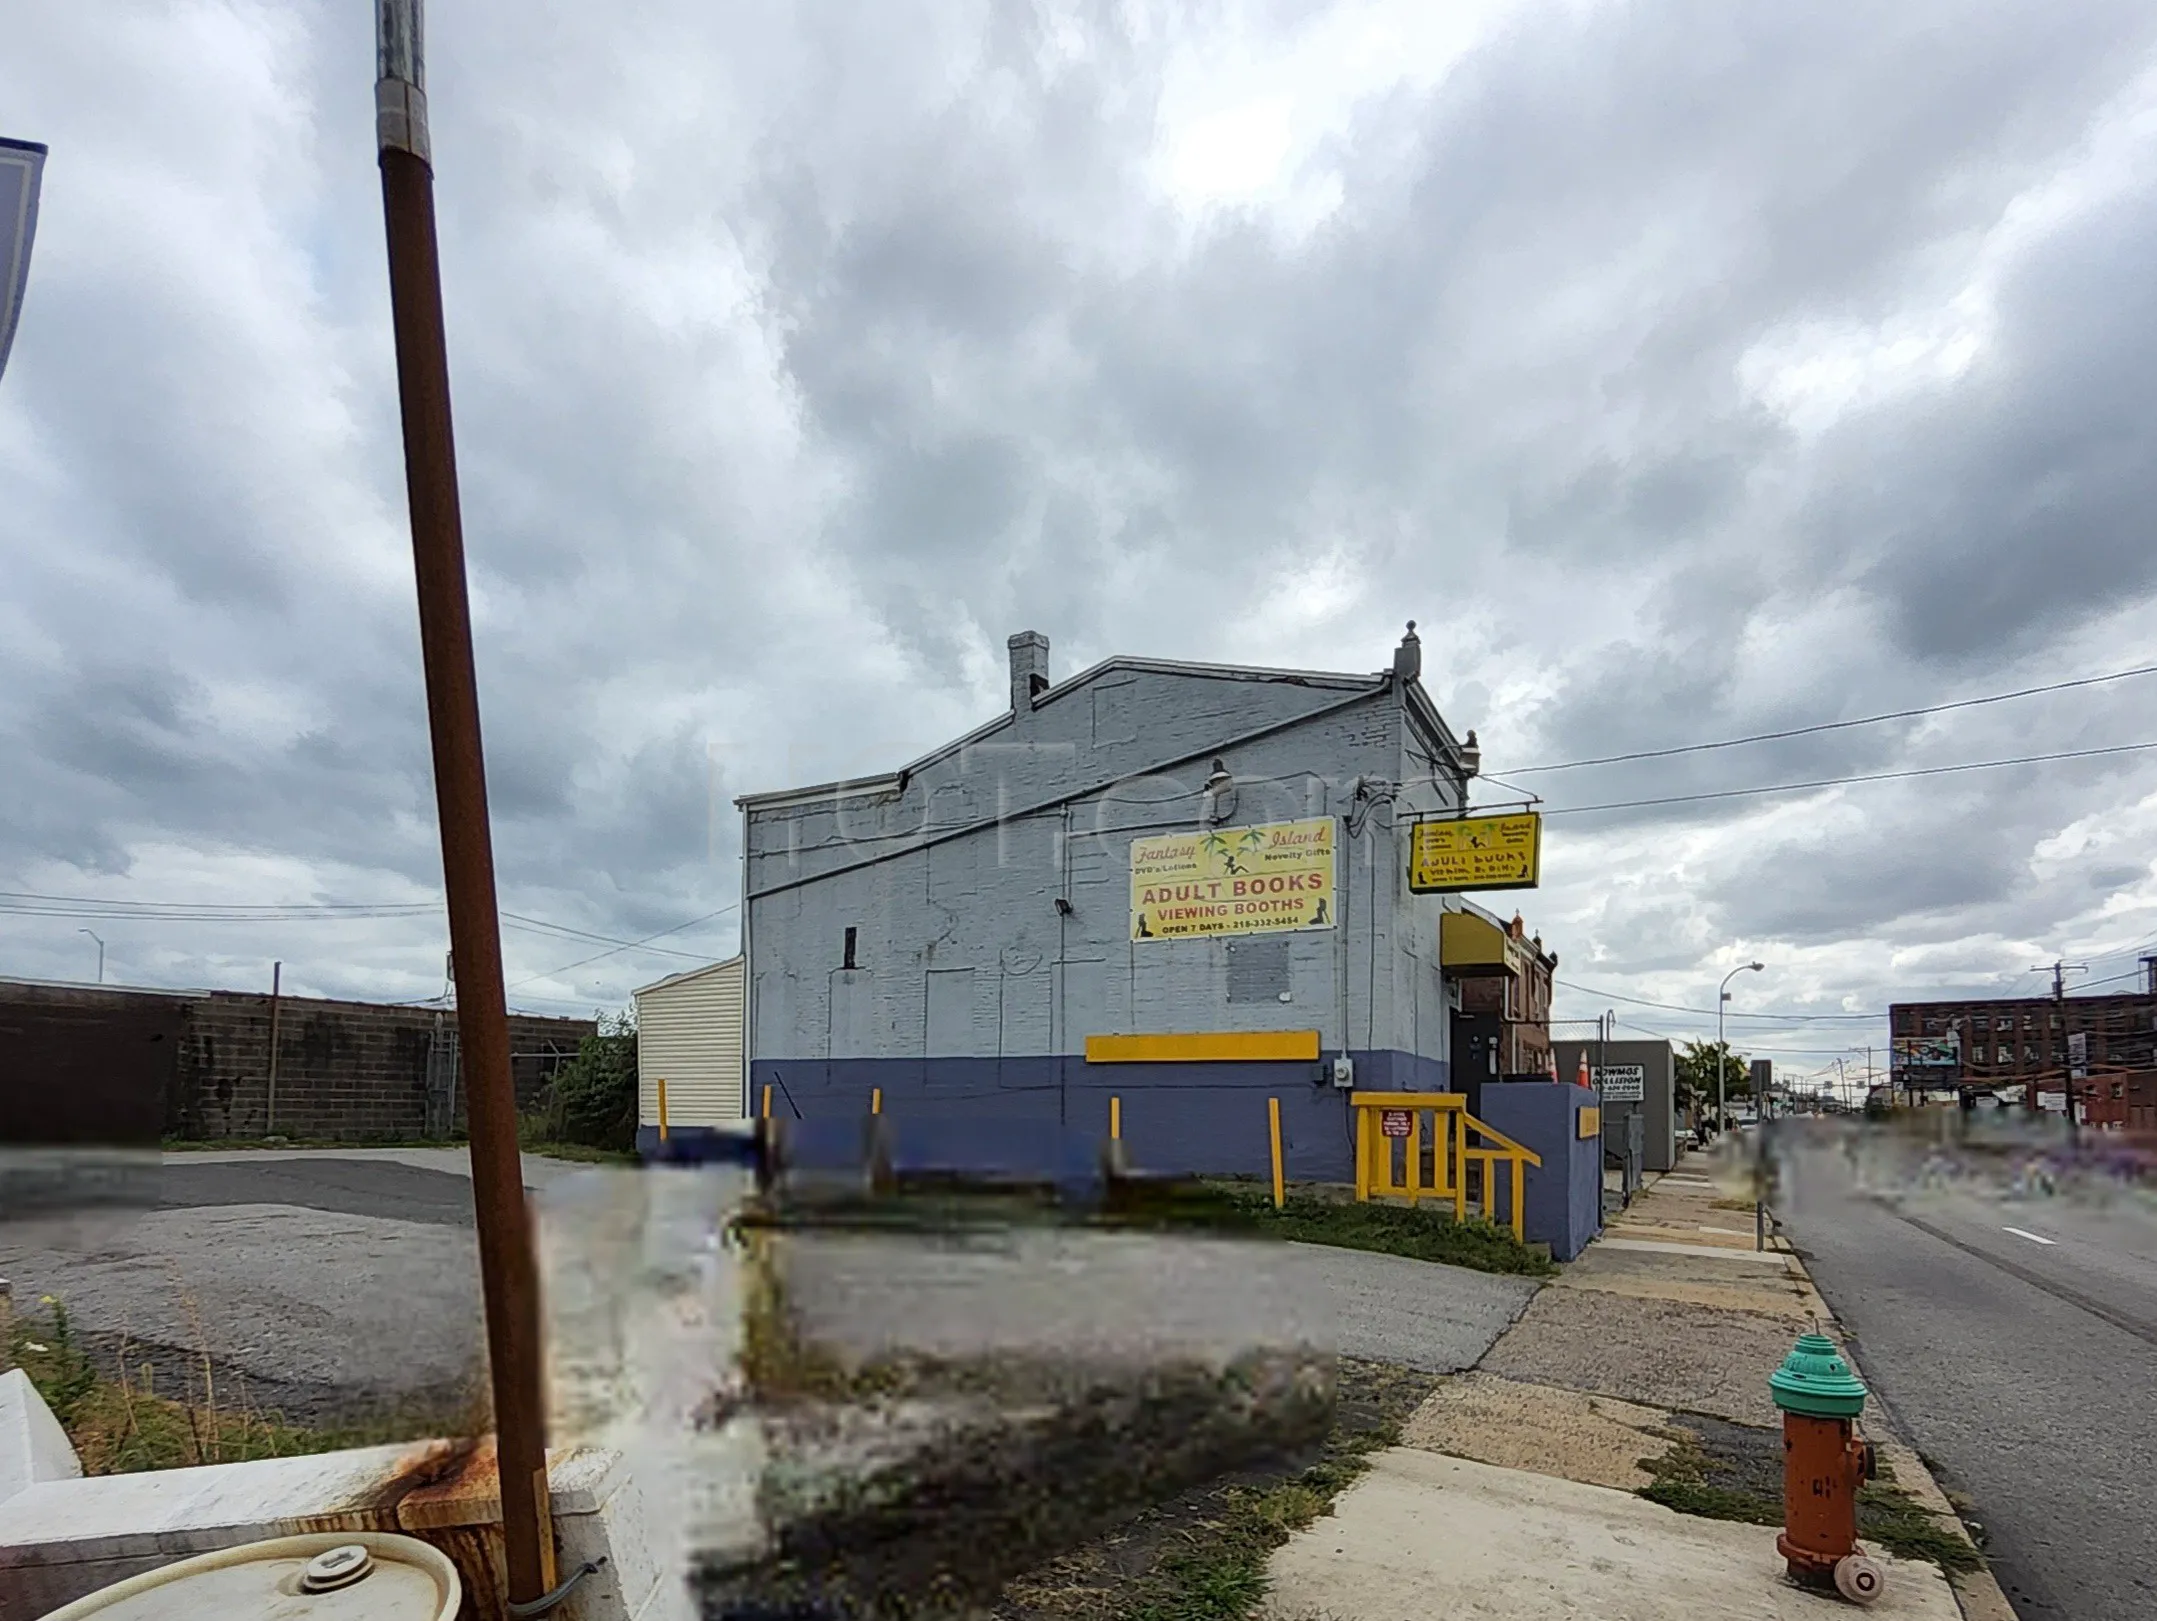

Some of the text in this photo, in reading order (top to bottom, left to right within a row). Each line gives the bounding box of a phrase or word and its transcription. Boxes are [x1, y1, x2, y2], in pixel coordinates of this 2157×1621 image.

[1135, 826, 1325, 864] Fantasy Island
[1264, 852, 1302, 861] Novelty
[1305, 848, 1331, 858] Gifts
[1142, 873, 1323, 905] ADULT BOOKS
[1157, 898, 1304, 921] VIEWING BOOTHS
[1162, 925, 1188, 934] OPEN
[1191, 924, 1197, 932] 7
[1199, 922, 1225, 932] DAYS
[1233, 916, 1299, 929] 215-332-5454
